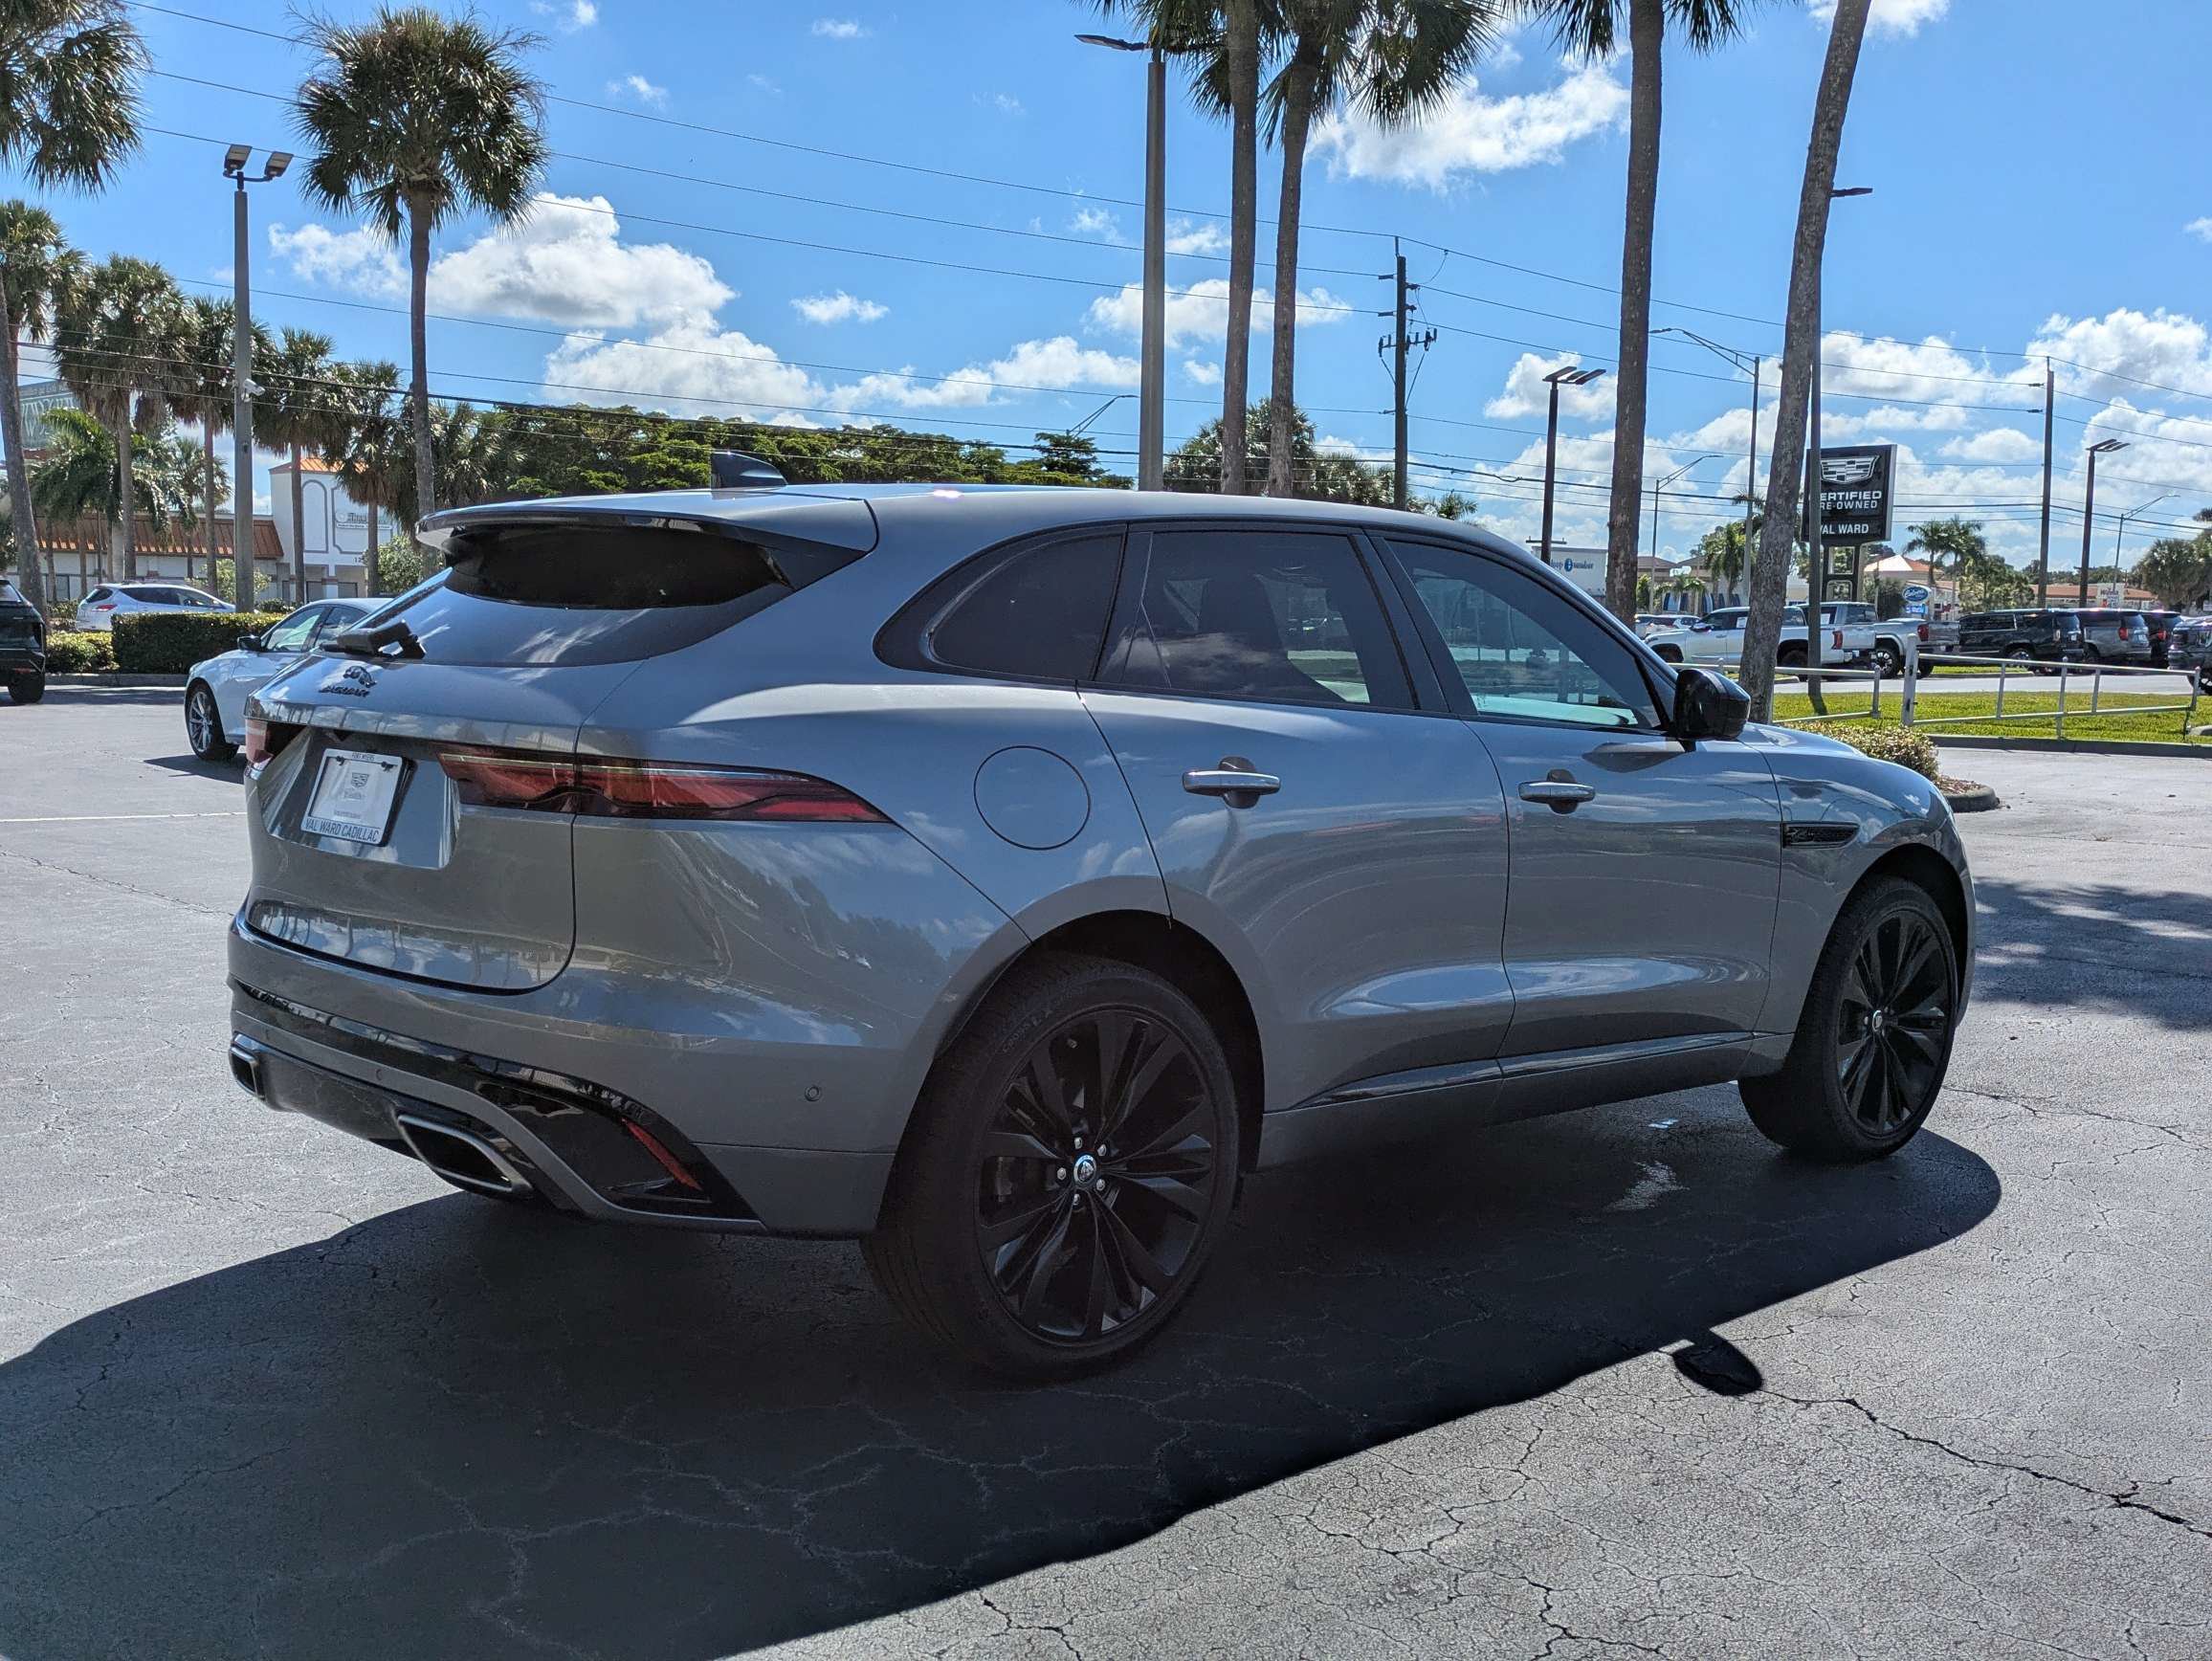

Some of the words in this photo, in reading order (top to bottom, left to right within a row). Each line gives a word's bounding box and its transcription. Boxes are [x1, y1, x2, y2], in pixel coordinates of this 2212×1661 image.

[1809, 490, 1882, 501] ERTIFIED
[1820, 500, 1877, 510] RE-OWNED
[1838, 523, 1869, 534] WARD
[306, 818, 318, 830] VAL
[320, 820, 340, 835] WARD
[342, 825, 379, 842] CADILLAC
